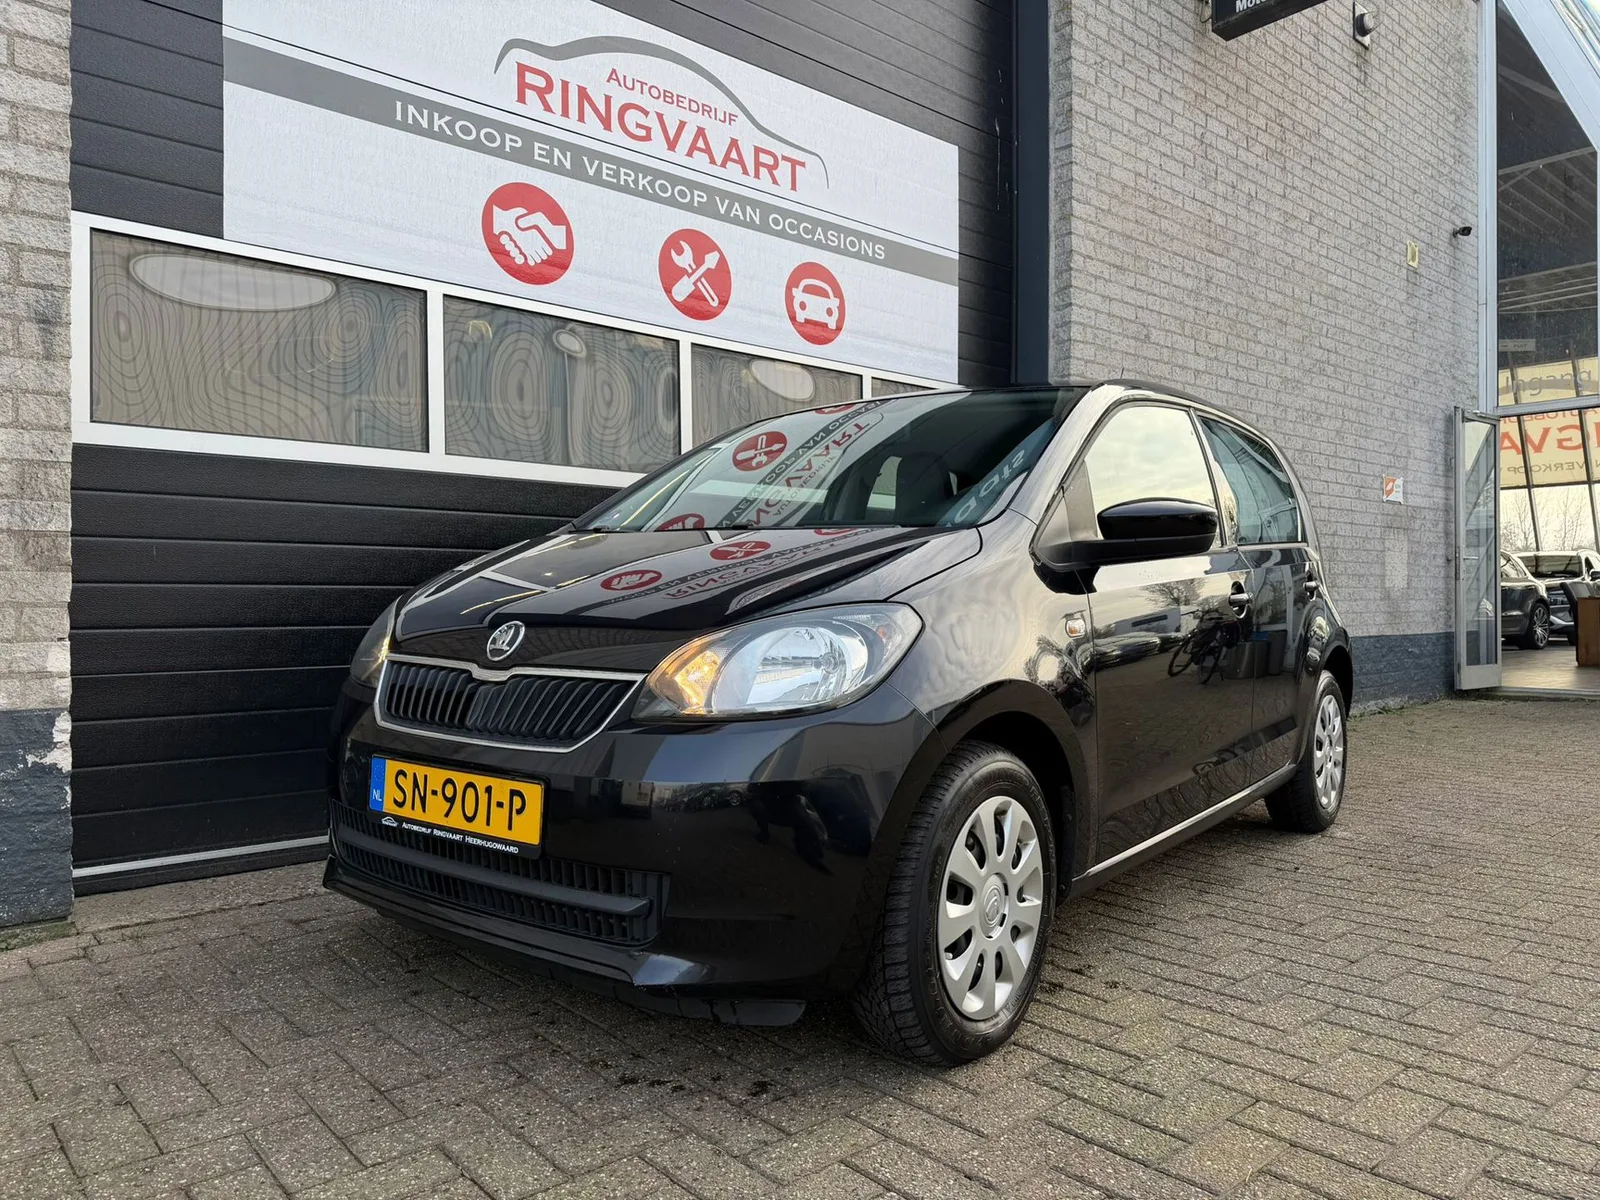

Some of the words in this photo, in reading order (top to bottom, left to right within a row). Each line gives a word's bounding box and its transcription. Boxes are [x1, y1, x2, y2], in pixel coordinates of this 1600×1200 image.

[515, 61, 806, 192] RINGVAART
[606, 68, 738, 126] AUTOBEDRIJF
[395, 101, 522, 153] INKOOP
[533, 141, 571, 170] EN
[582, 156, 707, 208] VERKOOP
[715, 195, 760, 225] VAN
[768, 214, 885, 260] OCCASIONS
[372, 788, 383, 802] NL
[393, 769, 527, 831] SN-901-P
[433, 828, 464, 842] RINGVAART
[465, 835, 519, 854] HEERHUGOWAARD
